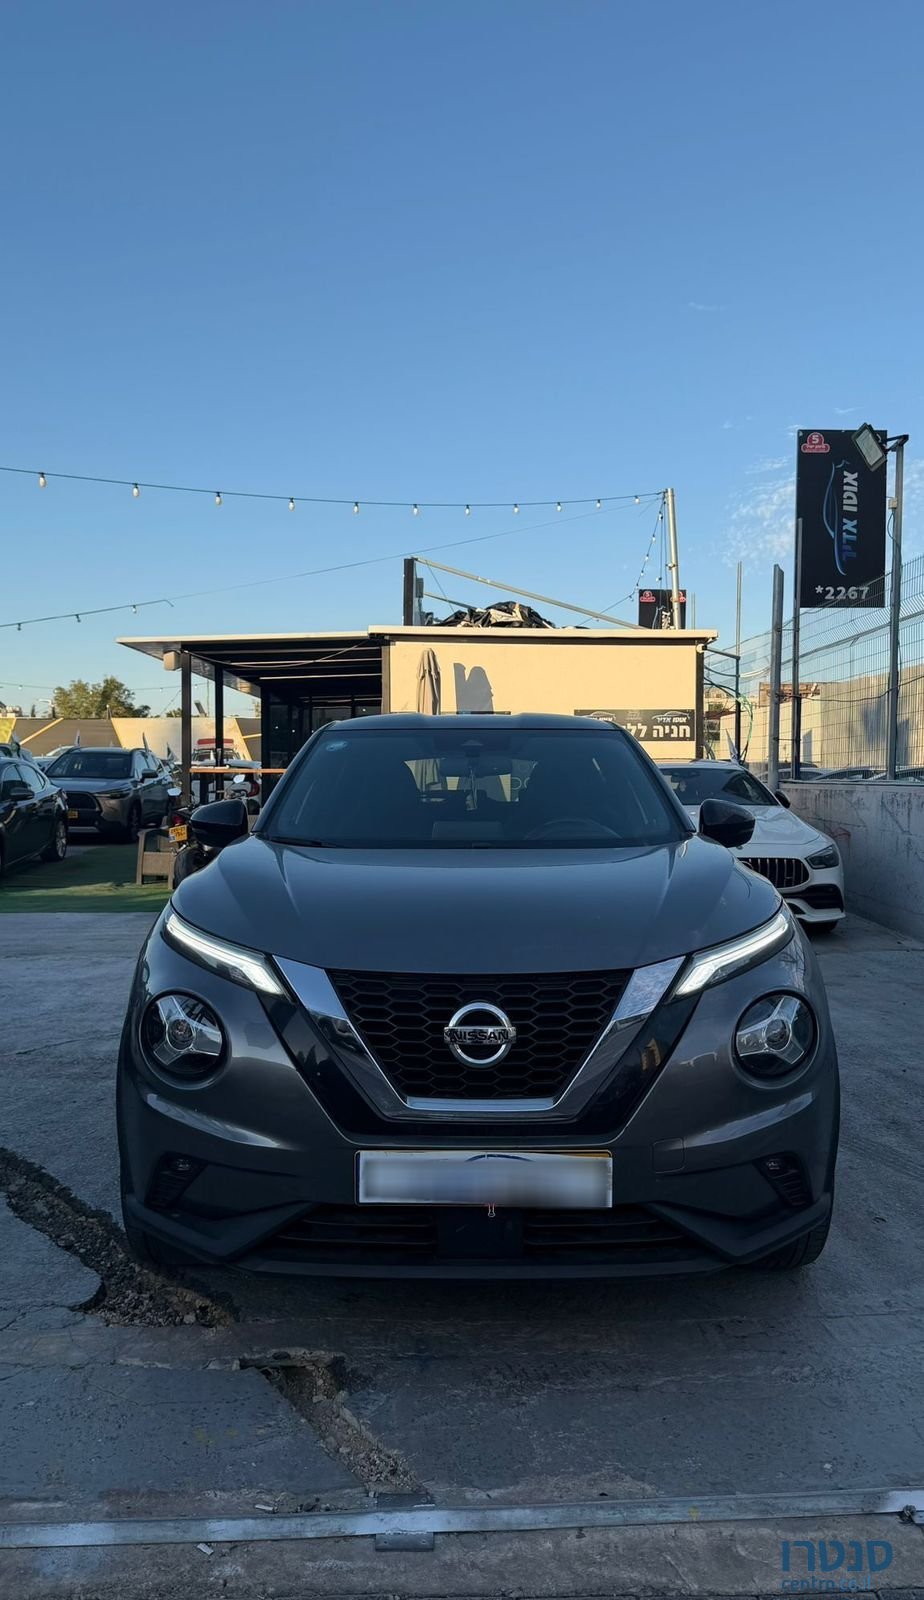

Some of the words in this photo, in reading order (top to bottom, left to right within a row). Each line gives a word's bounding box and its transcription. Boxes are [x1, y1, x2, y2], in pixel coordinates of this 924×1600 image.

[811, 434, 820, 444] 5
[843, 470, 858, 512] אוטו
[843, 518, 857, 561] אדיר
[652, 724, 691, 738] חניה
[451, 1030, 509, 1041] NISSAN
